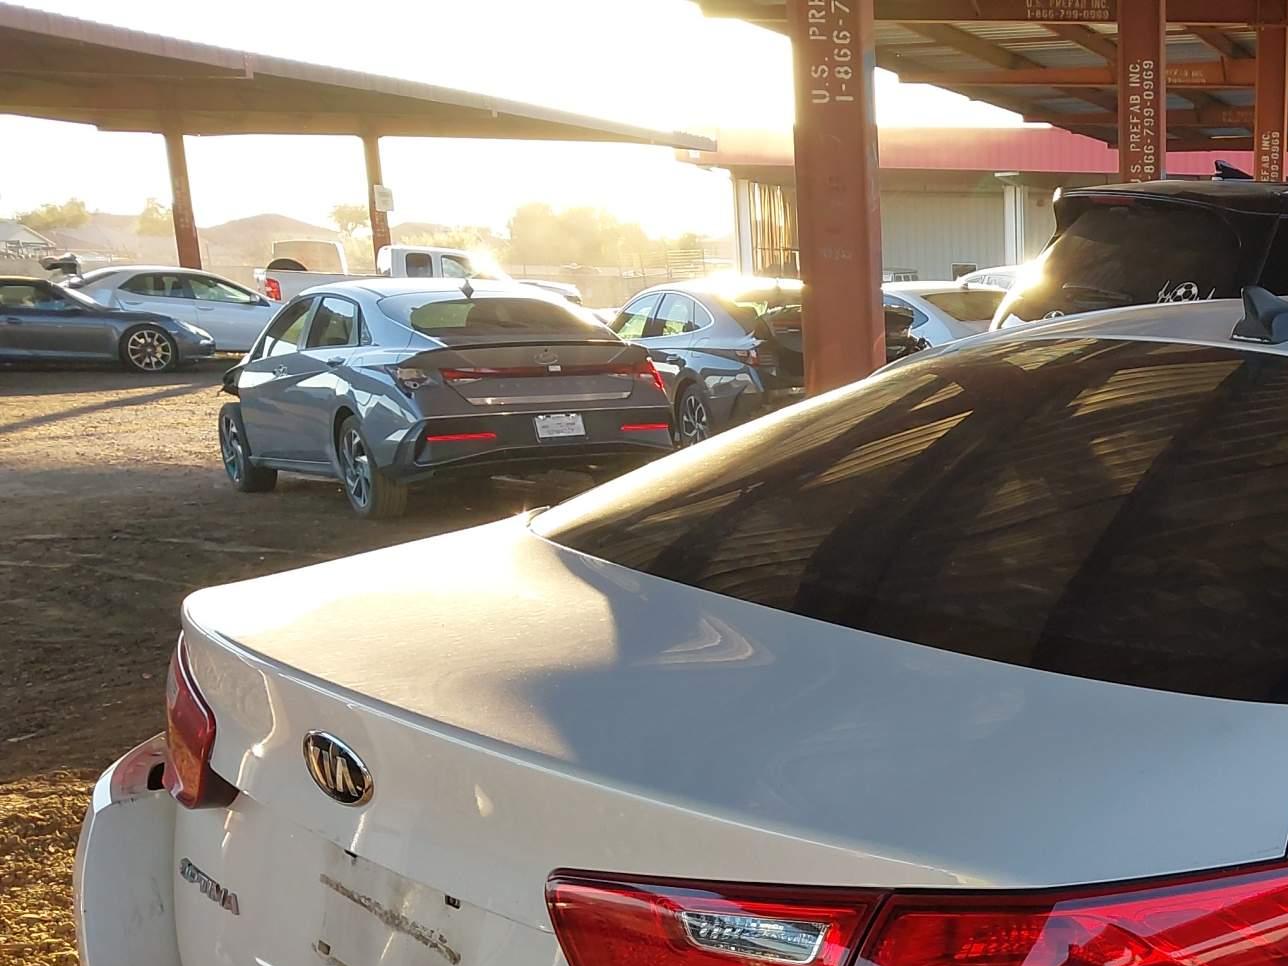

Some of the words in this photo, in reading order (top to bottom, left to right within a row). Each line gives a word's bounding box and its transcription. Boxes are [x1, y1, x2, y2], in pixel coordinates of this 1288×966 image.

[811, 57, 830, 104] U.S.
[1129, 59, 1140, 87] INC.
[1129, 95, 1141, 151] PREFAB
[180, 857, 240, 915] OPTIMA
